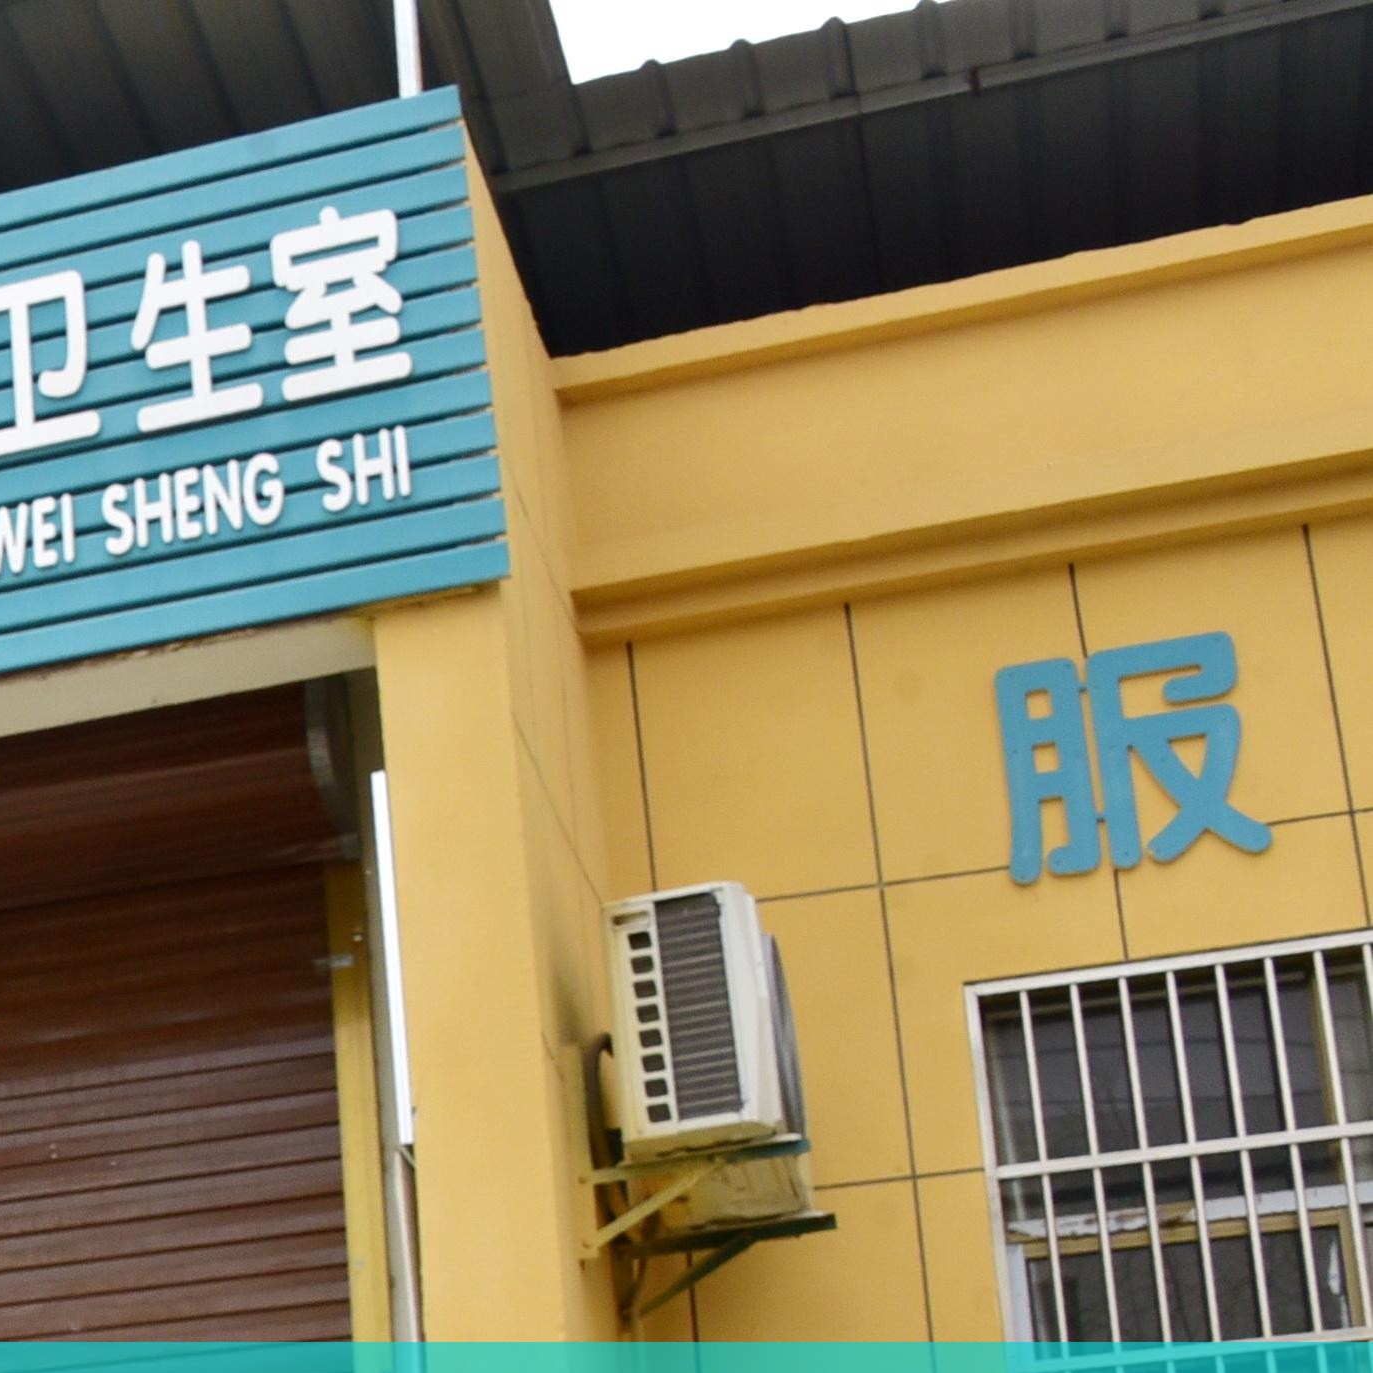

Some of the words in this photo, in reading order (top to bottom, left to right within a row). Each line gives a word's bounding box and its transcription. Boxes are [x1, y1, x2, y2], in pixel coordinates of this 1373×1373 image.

[102, 453, 285, 556] SHENG
[316, 425, 412, 512] SHI
[994, 630, 1273, 886] 服
